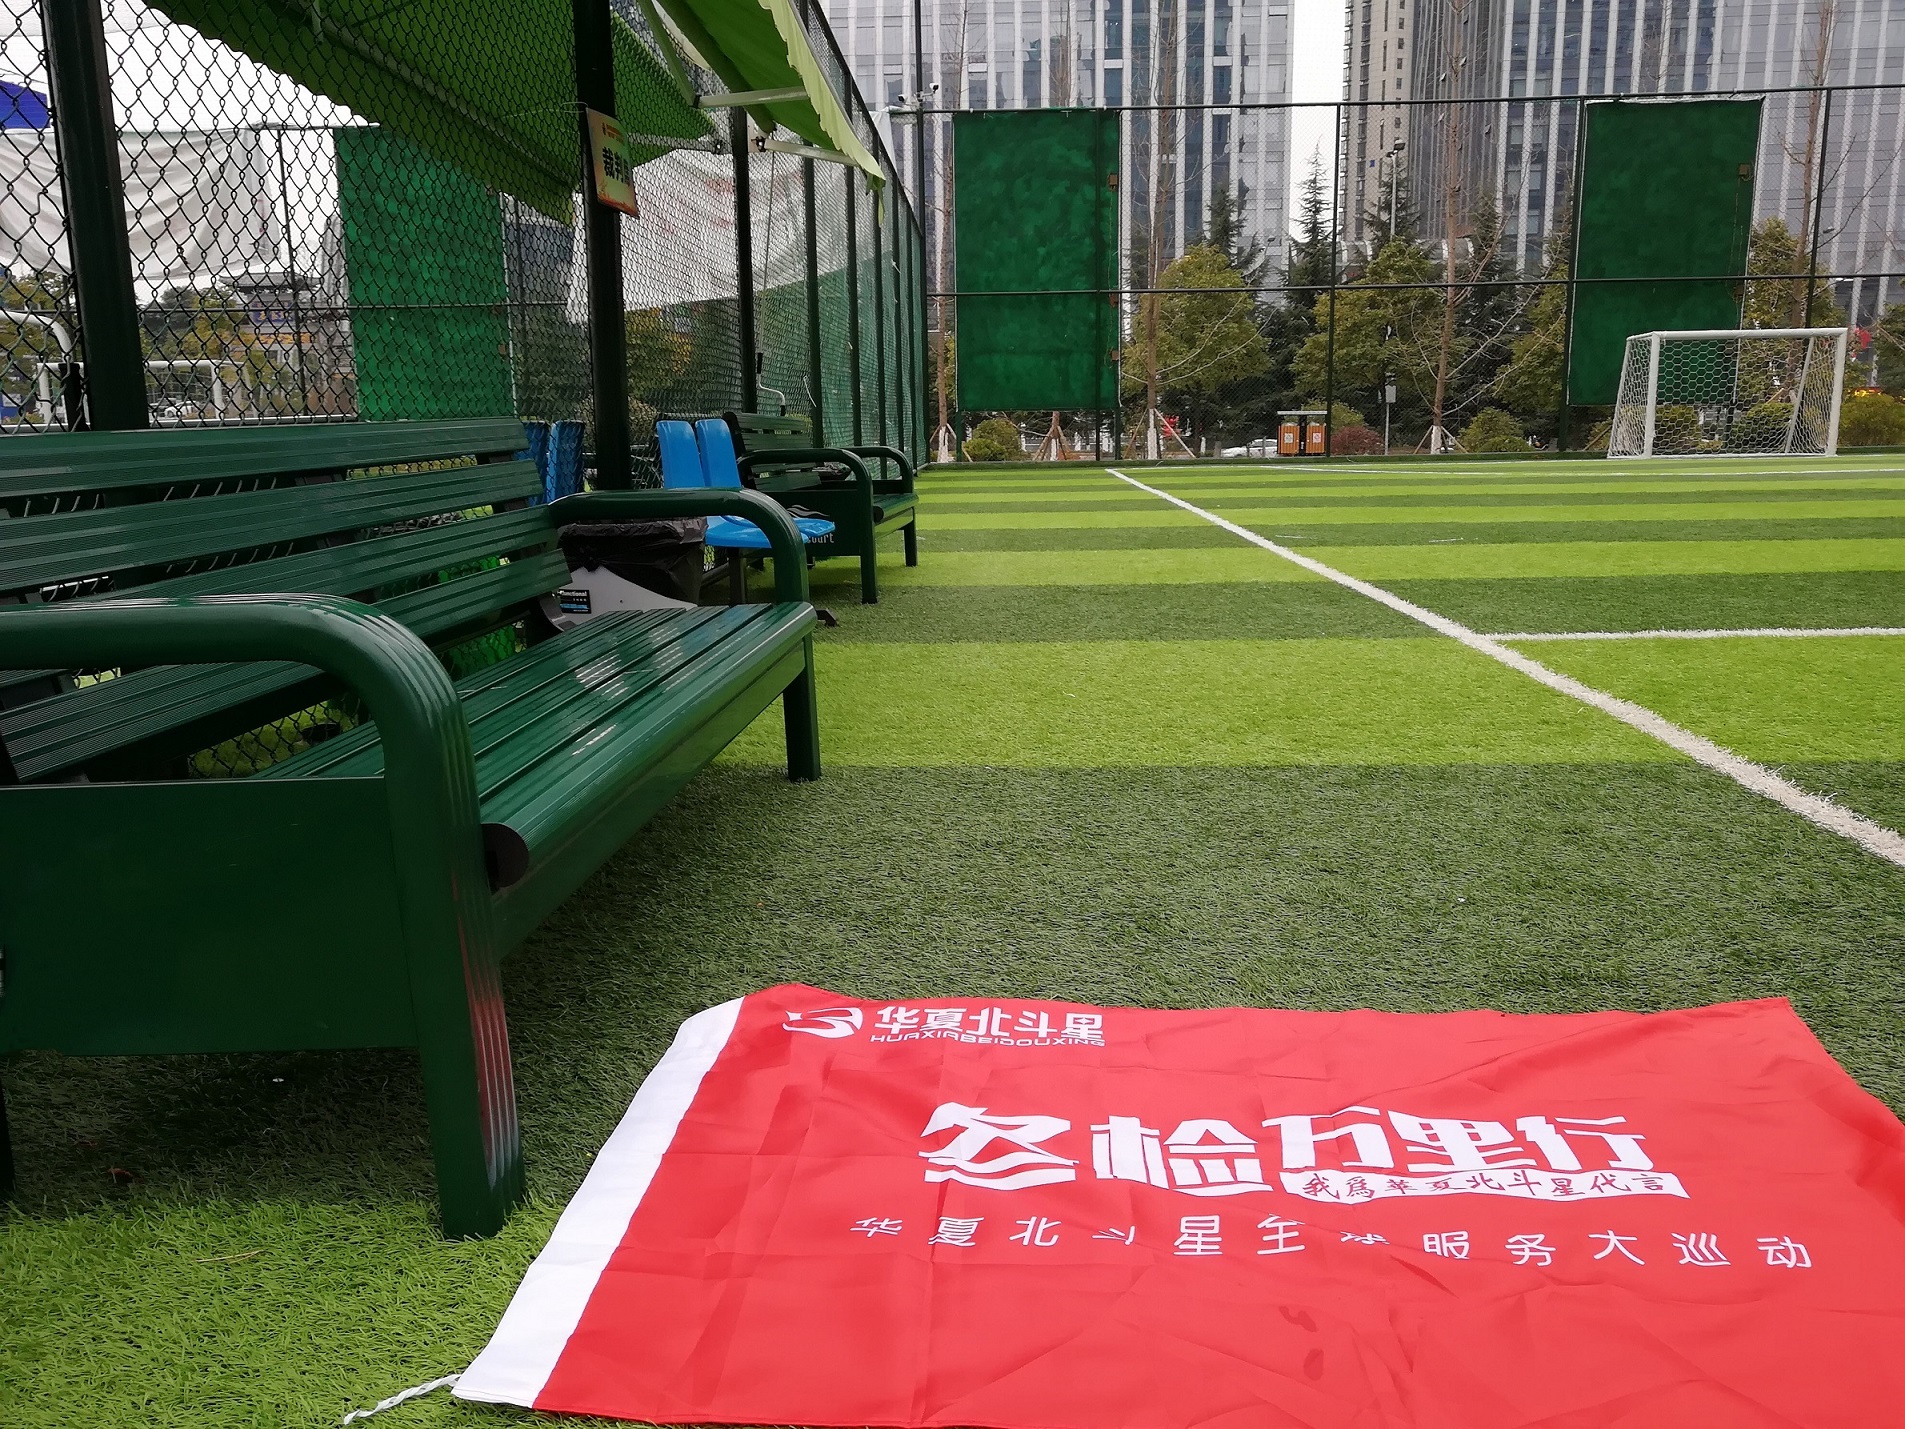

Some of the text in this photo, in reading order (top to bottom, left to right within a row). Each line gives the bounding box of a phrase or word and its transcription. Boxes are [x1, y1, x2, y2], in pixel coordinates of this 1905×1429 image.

[869, 1030, 1106, 1047] HUAXIABEIDOUXING
[872, 1005, 1104, 1041] 华夏北斗星
[919, 1101, 1654, 1196] 冬检万里行
